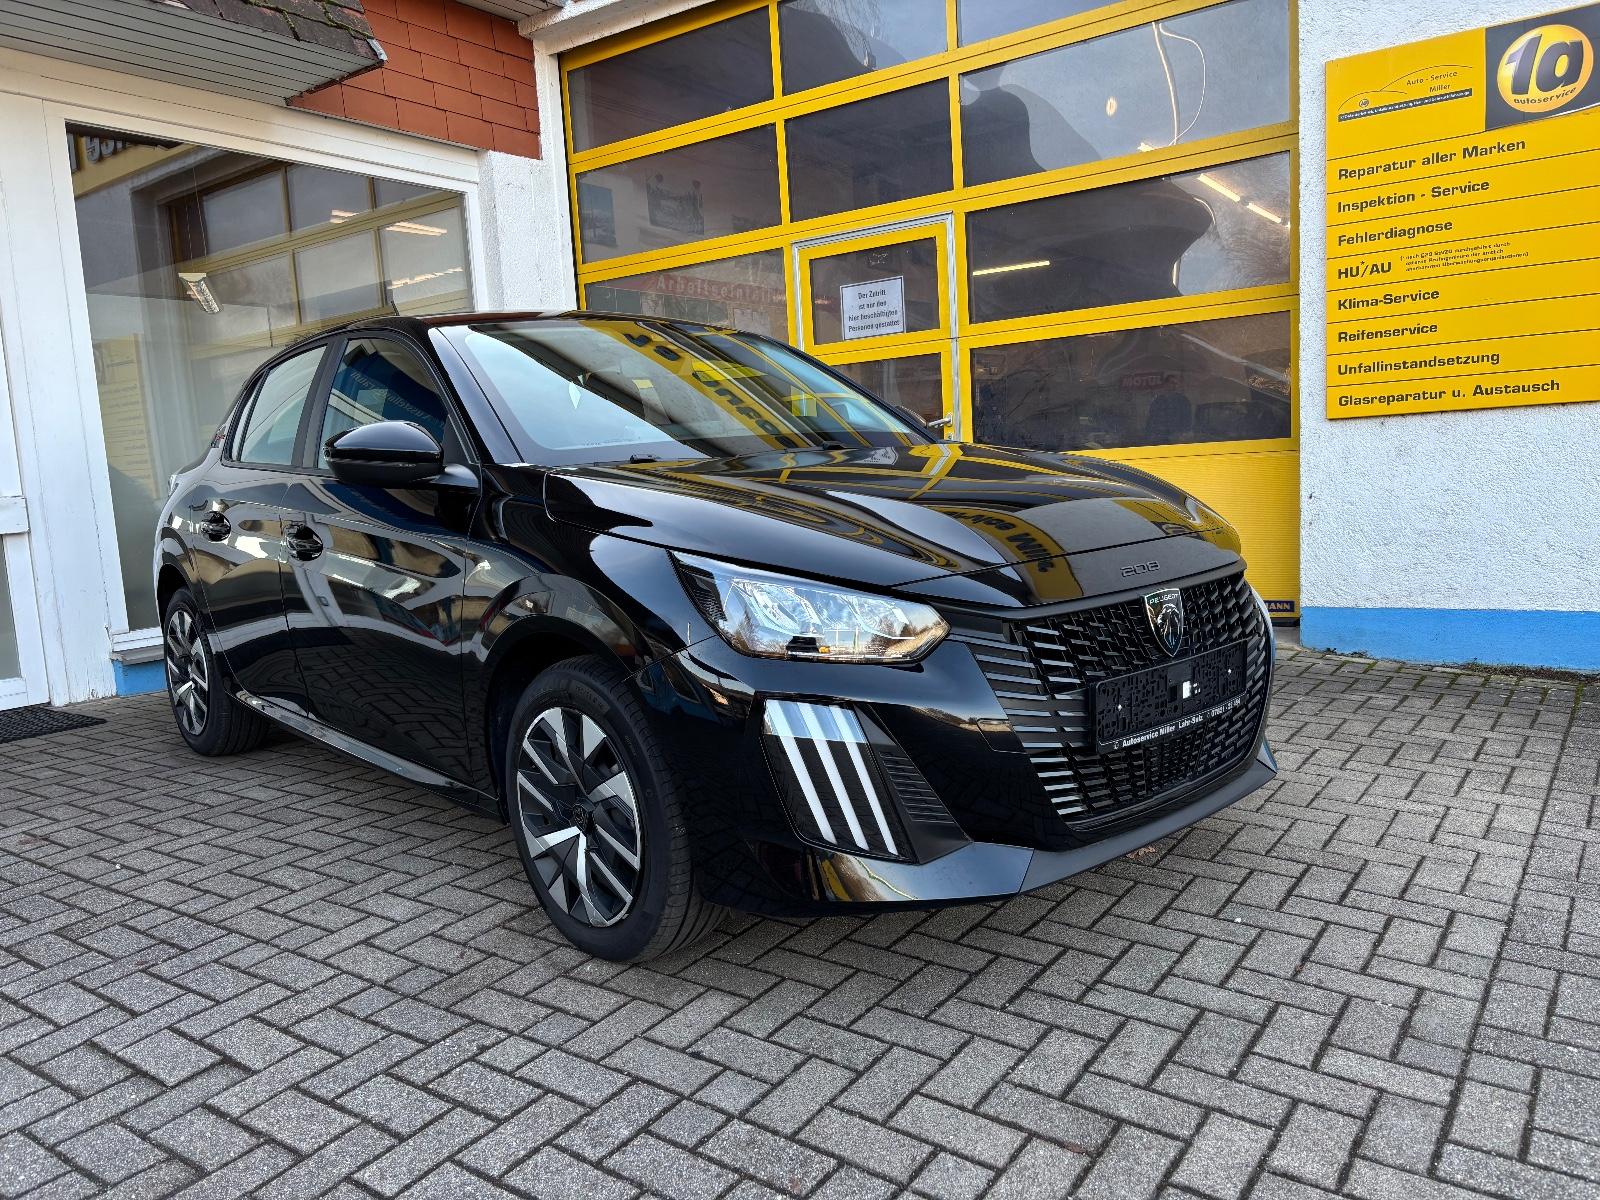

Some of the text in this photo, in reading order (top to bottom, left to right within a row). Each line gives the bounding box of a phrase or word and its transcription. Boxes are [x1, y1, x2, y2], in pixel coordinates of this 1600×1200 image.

[1504, 34, 1583, 95] 1a
[1406, 78, 1424, 86] Auto
[1430, 71, 1458, 82] Service
[1429, 84, 1451, 93] Miller
[1513, 86, 1577, 105] autoservice
[1338, 139, 1526, 181] Reparatur aller Marken
[1337, 191, 1416, 213] Inspektion
[1431, 180, 1490, 199] Service
[1338, 220, 1453, 247] Fehlerdiagnose
[1338, 288, 1440, 311] Klima-Service
[1338, 323, 1438, 343] Reifenservice
[1338, 351, 1500, 376] Unfallinstandsetzung
[1338, 379, 1561, 408] Glasreparatur u. Austausch
[1120, 560, 1160, 577] 208
[1149, 593, 1179, 605] PEUGEOT
[1122, 730, 1159, 747] Autoservice
